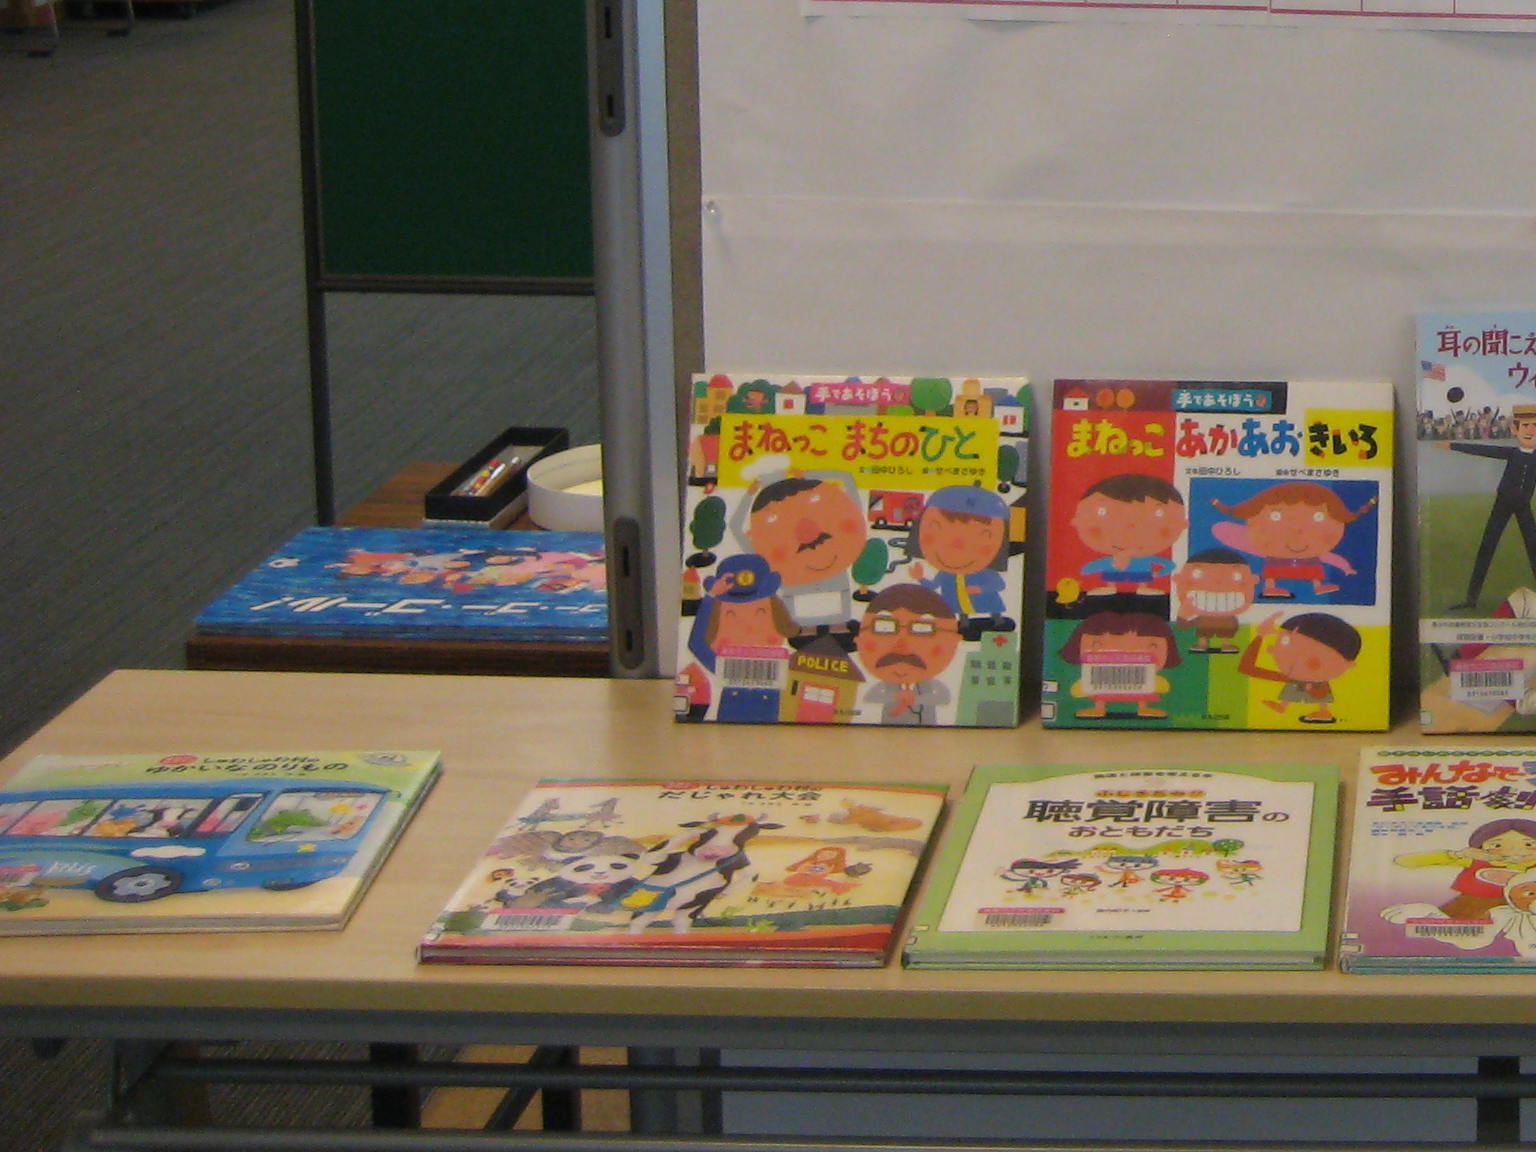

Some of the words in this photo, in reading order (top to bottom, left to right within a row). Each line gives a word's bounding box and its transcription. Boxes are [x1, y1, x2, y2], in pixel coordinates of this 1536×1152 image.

[728, 421, 828, 461] まねっこ
[842, 422, 981, 461] まちのひと
[1066, 419, 1166, 458] まねっこ
[796, 654, 850, 673] POLICE
[1370, 759, 1527, 786] みんなで
[1022, 798, 1291, 824] 聴覚障害の
[1068, 825, 1216, 838] おともだち
